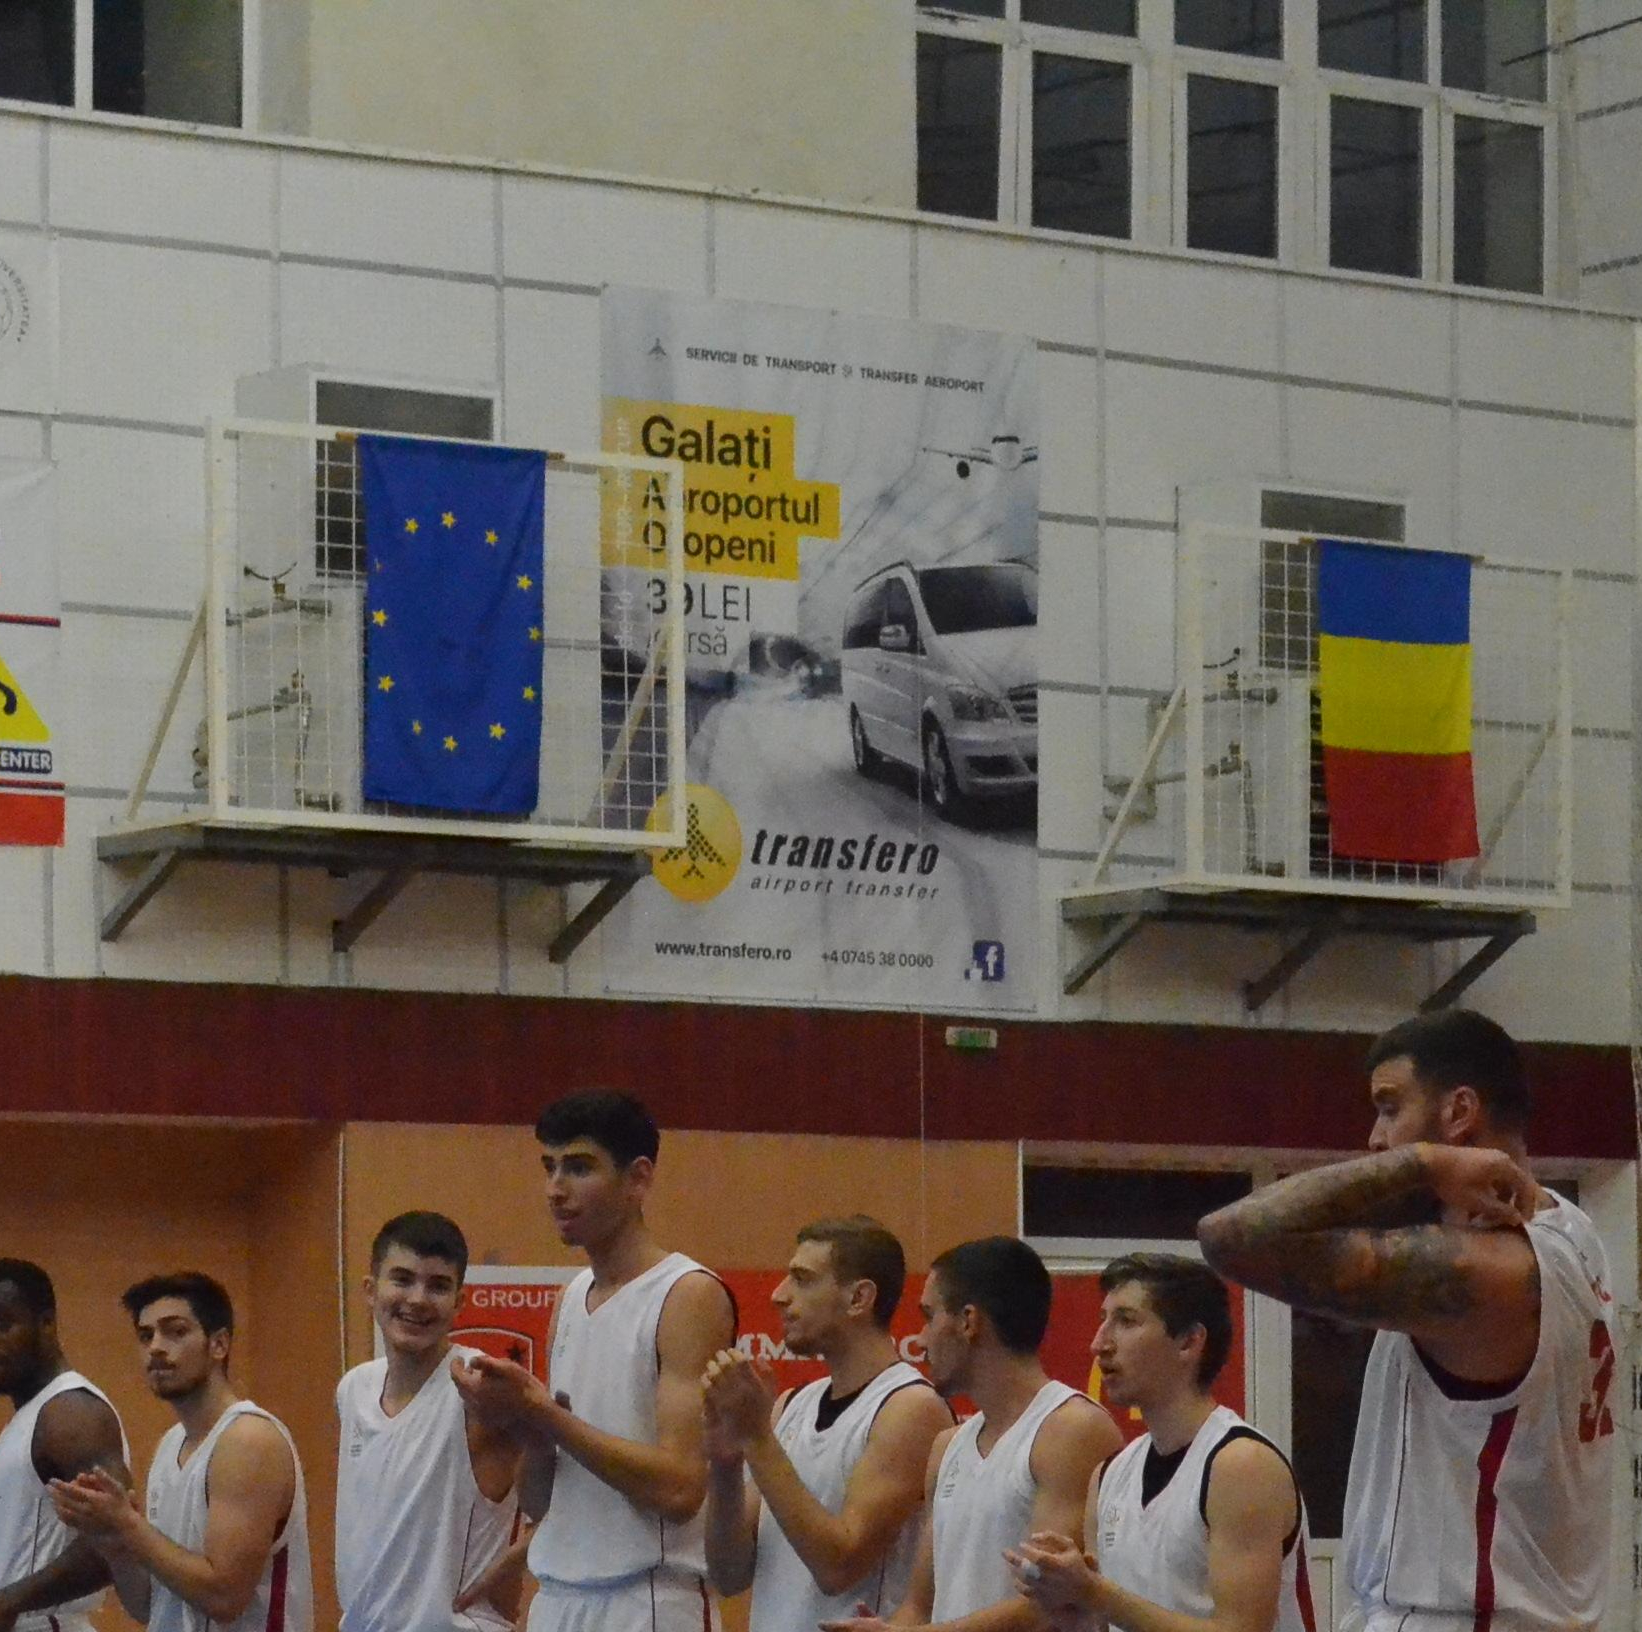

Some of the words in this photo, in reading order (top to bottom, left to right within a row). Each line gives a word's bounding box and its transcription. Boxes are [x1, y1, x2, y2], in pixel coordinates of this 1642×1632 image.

[686, 346, 737, 364] SERVICII
[743, 352, 759, 366] DE
[765, 356, 837, 376] TRANSPORT
[860, 367, 918, 385] TRANSFER
[924, 375, 985, 393] AEROPORT
[641, 415, 773, 483] Galați
[642, 477, 821, 526] Aroportul
[642, 519, 776, 566] Oopeni
[701, 582, 751, 622] LEI
[751, 829, 940, 876] transfero
[751, 873, 834, 895] airport
[846, 879, 940, 900] transfer
[655, 940, 792, 962] www.transfero.ro
